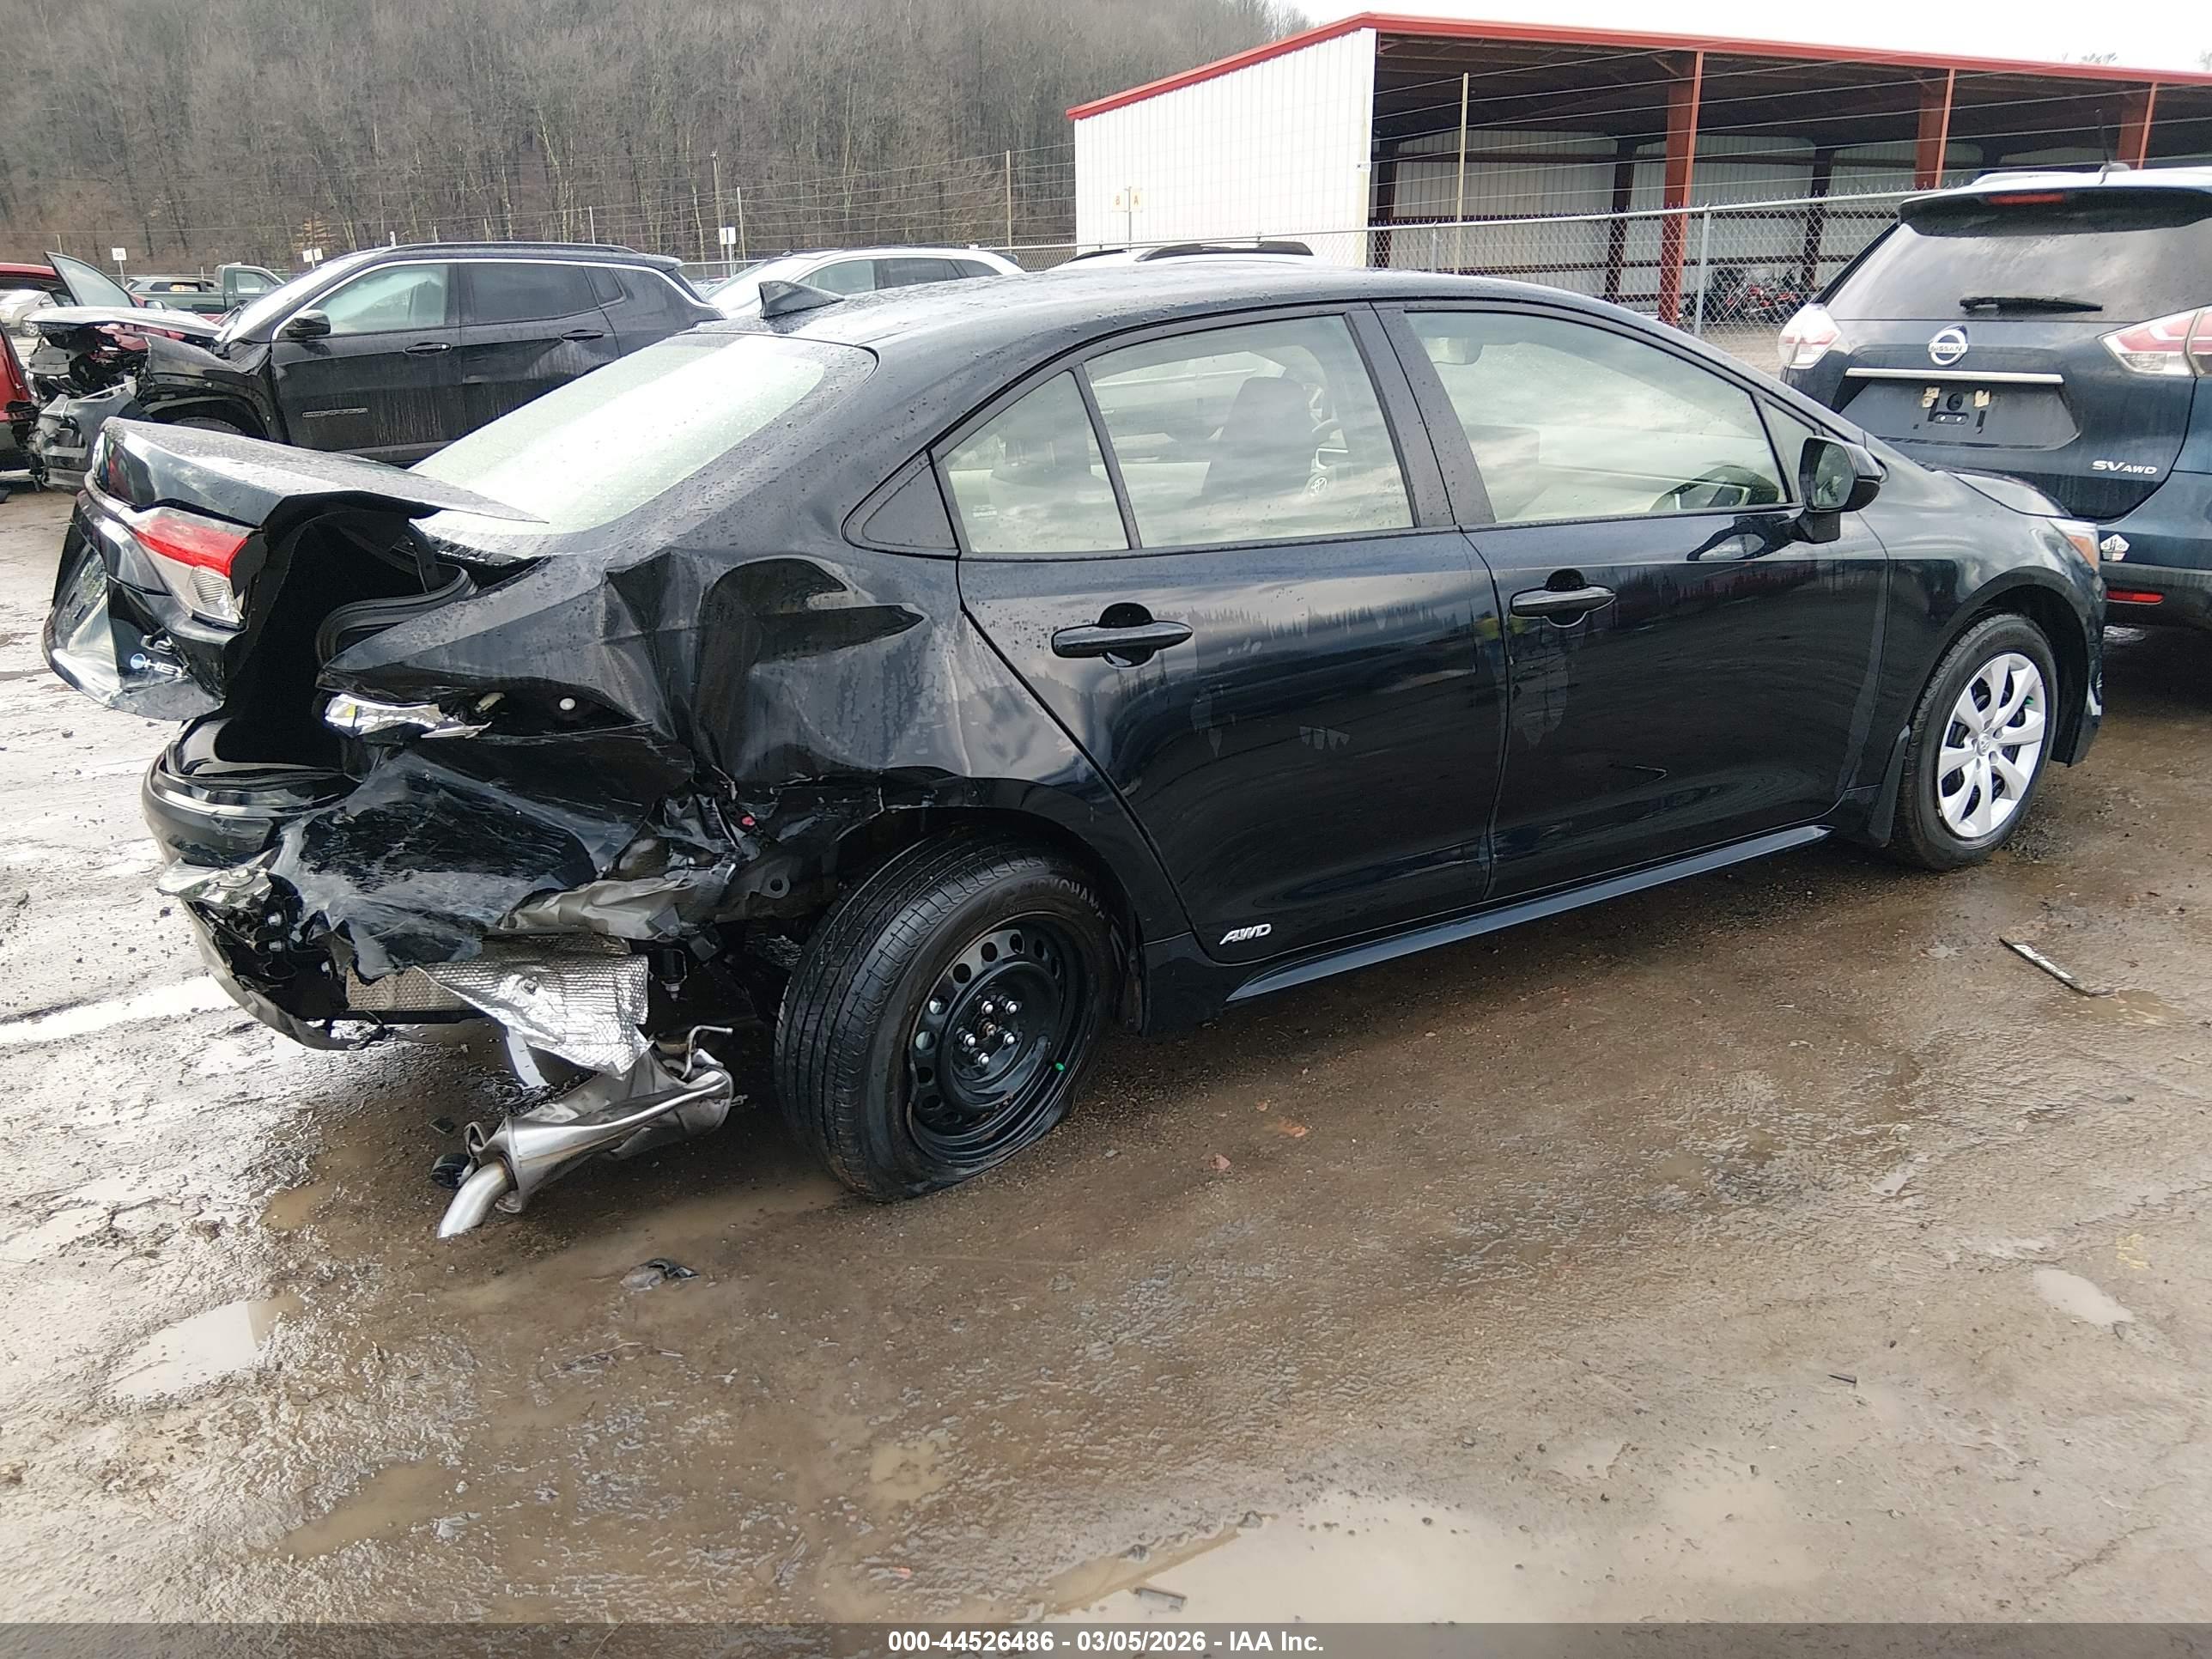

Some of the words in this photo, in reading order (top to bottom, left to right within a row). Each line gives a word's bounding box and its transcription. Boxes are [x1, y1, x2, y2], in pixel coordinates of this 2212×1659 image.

[2092, 459, 2126, 471] SV
[2121, 465, 2158, 475] AWD
[1218, 923, 1273, 945] AWD
